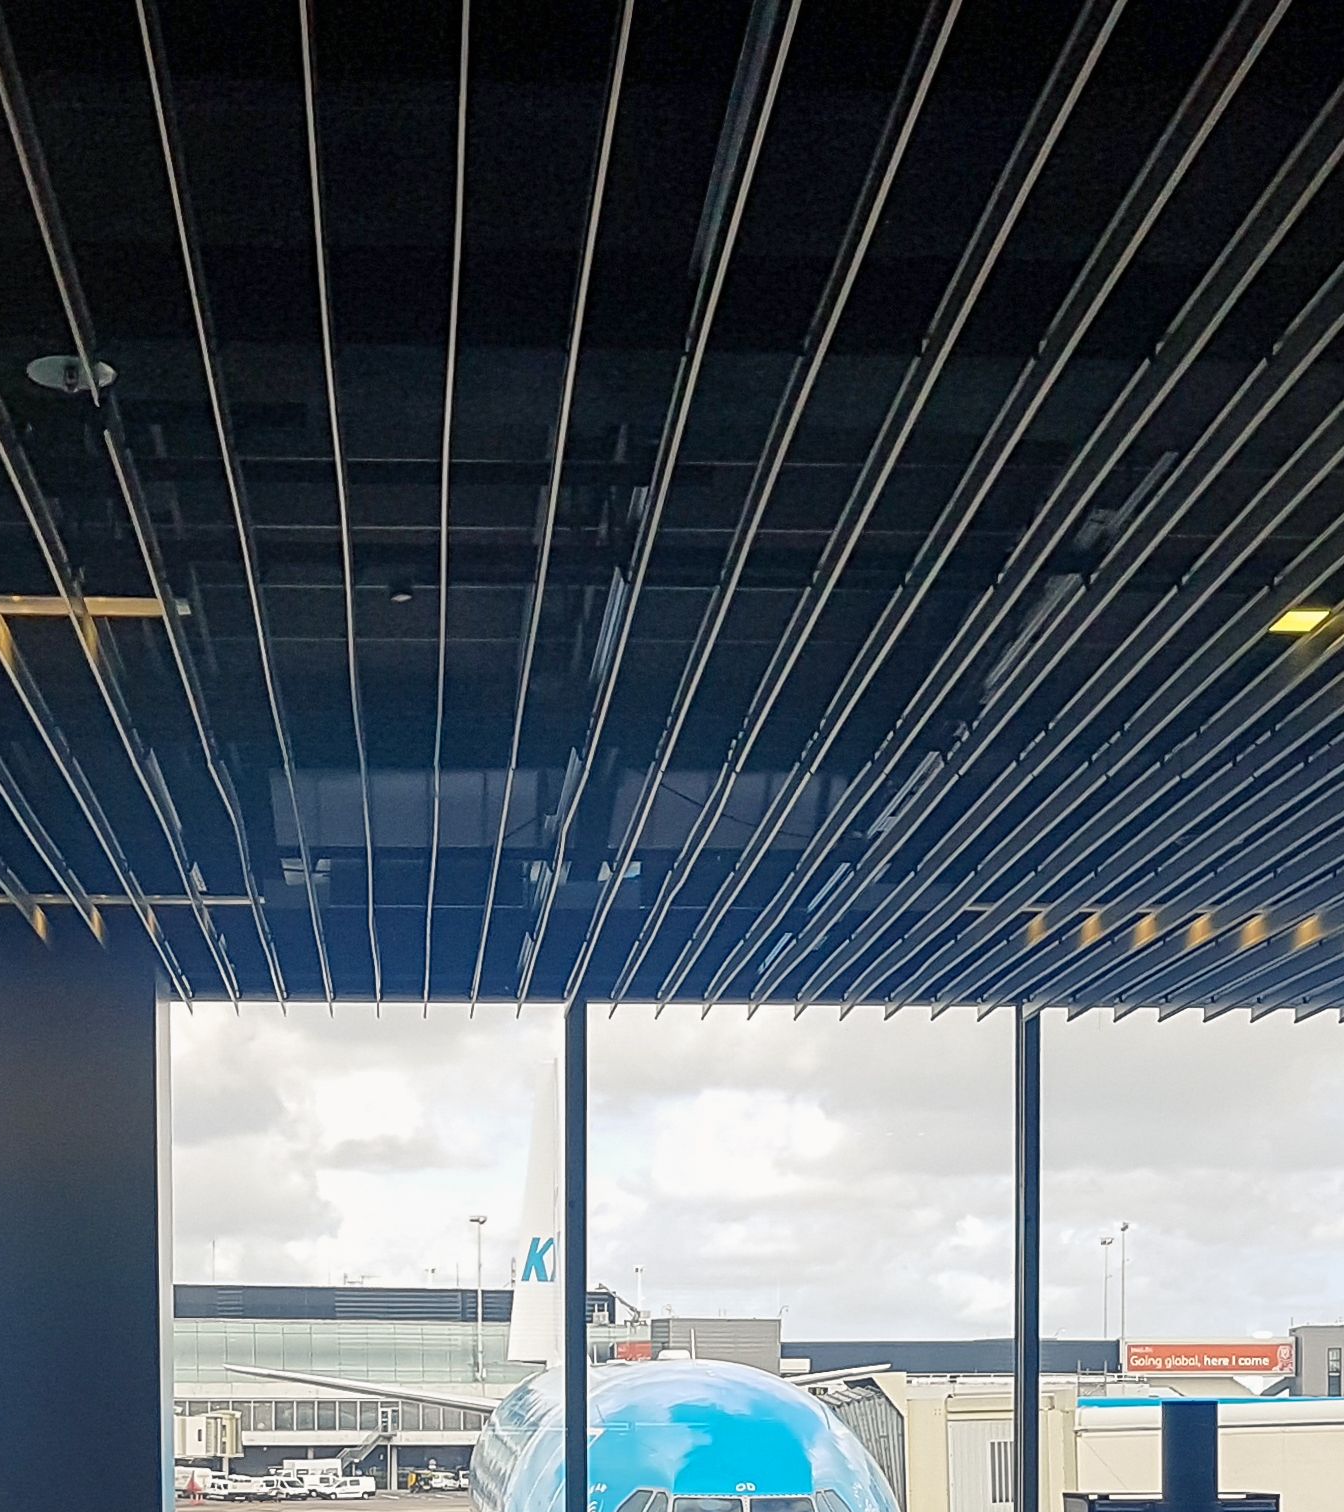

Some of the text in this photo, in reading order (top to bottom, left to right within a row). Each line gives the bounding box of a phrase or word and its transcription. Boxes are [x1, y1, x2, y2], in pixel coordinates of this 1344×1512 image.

[1130, 1355, 1162, 1368] Going
[1164, 1355, 1201, 1368] global,
[1203, 1355, 1229, 1366] here
[1238, 1356, 1270, 1366] come
